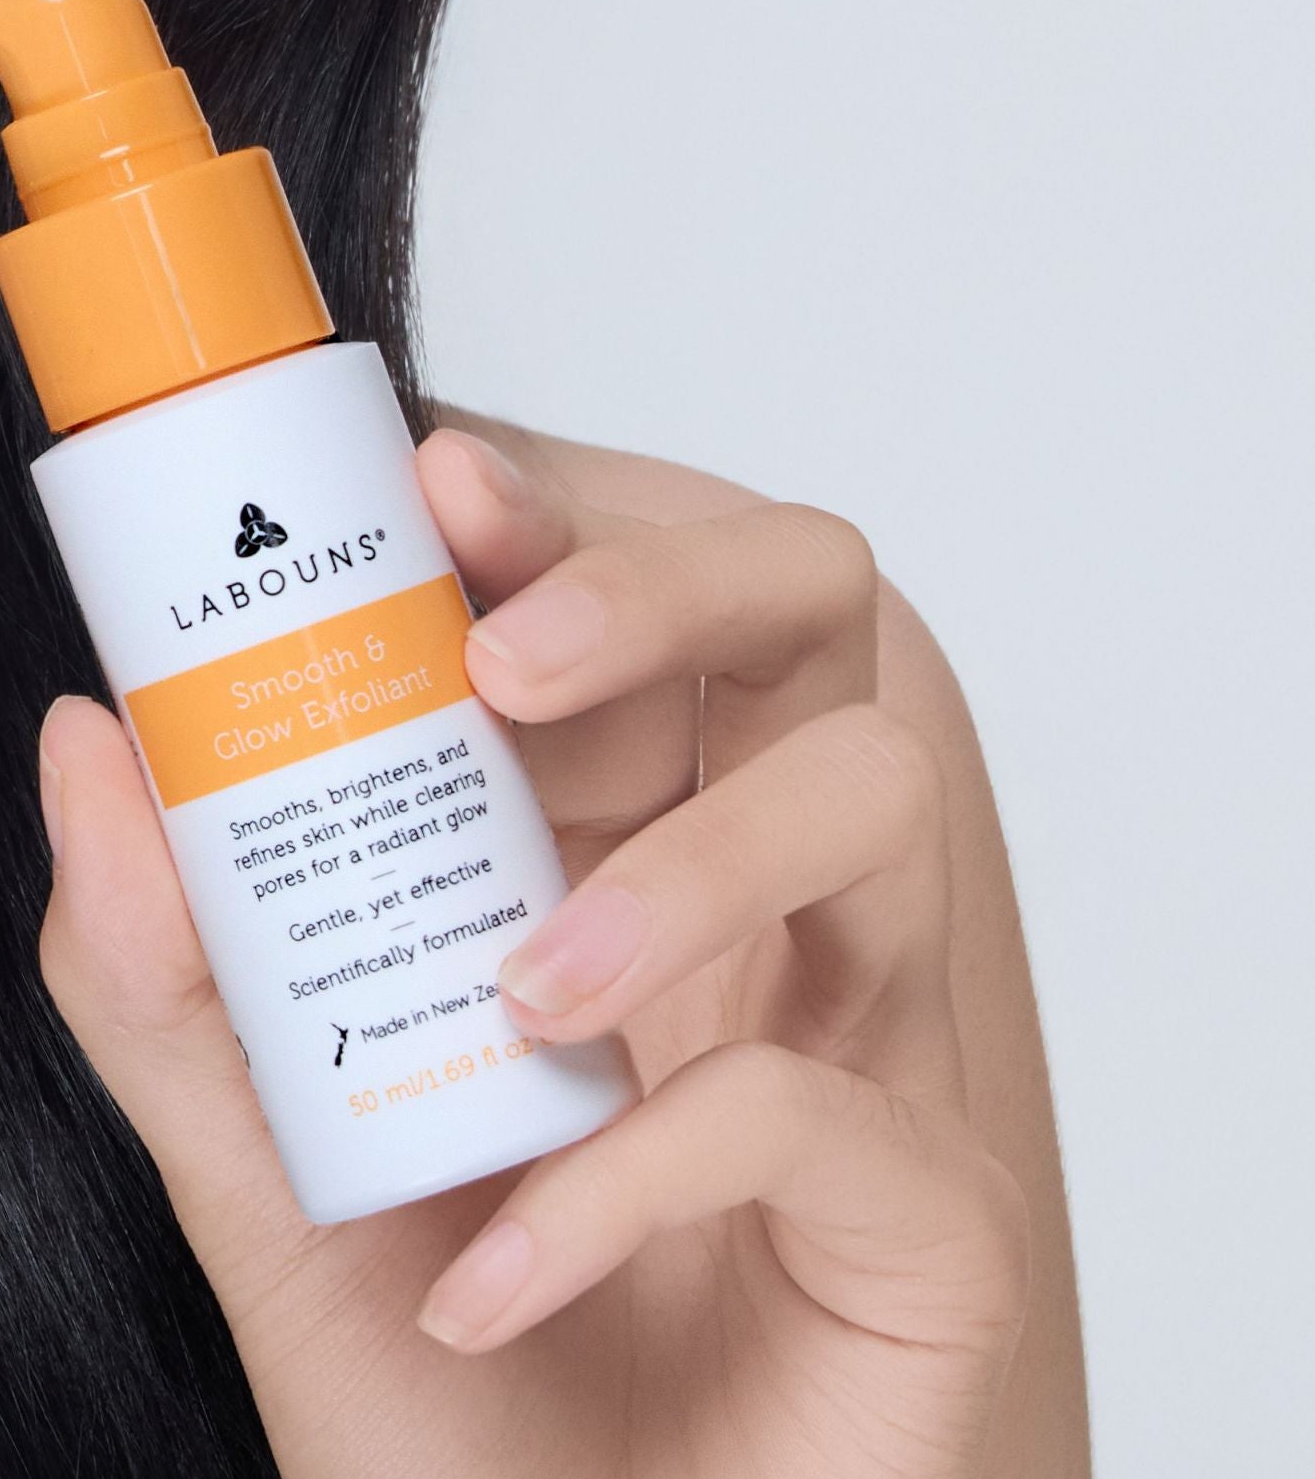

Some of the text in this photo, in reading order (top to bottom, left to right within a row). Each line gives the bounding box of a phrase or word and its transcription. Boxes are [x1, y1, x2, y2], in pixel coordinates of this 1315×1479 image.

[213, 666, 433, 761] Glow Exfoliant
[231, 634, 386, 710] Smooth &
[229, 739, 470, 841] Smooths, brightens, and
[233, 769, 487, 873] refines skin while clearing
[252, 801, 489, 902] pores for a radiant glow
[288, 857, 493, 942] Gentle, yet effective
[288, 899, 528, 1001] Scientifically formulated
[360, 1016, 409, 1044] Made
[412, 1009, 430, 1027] in
[431, 994, 471, 1019] New
[347, 1088, 380, 1118] 50
[504, 1036, 534, 1060] oz
